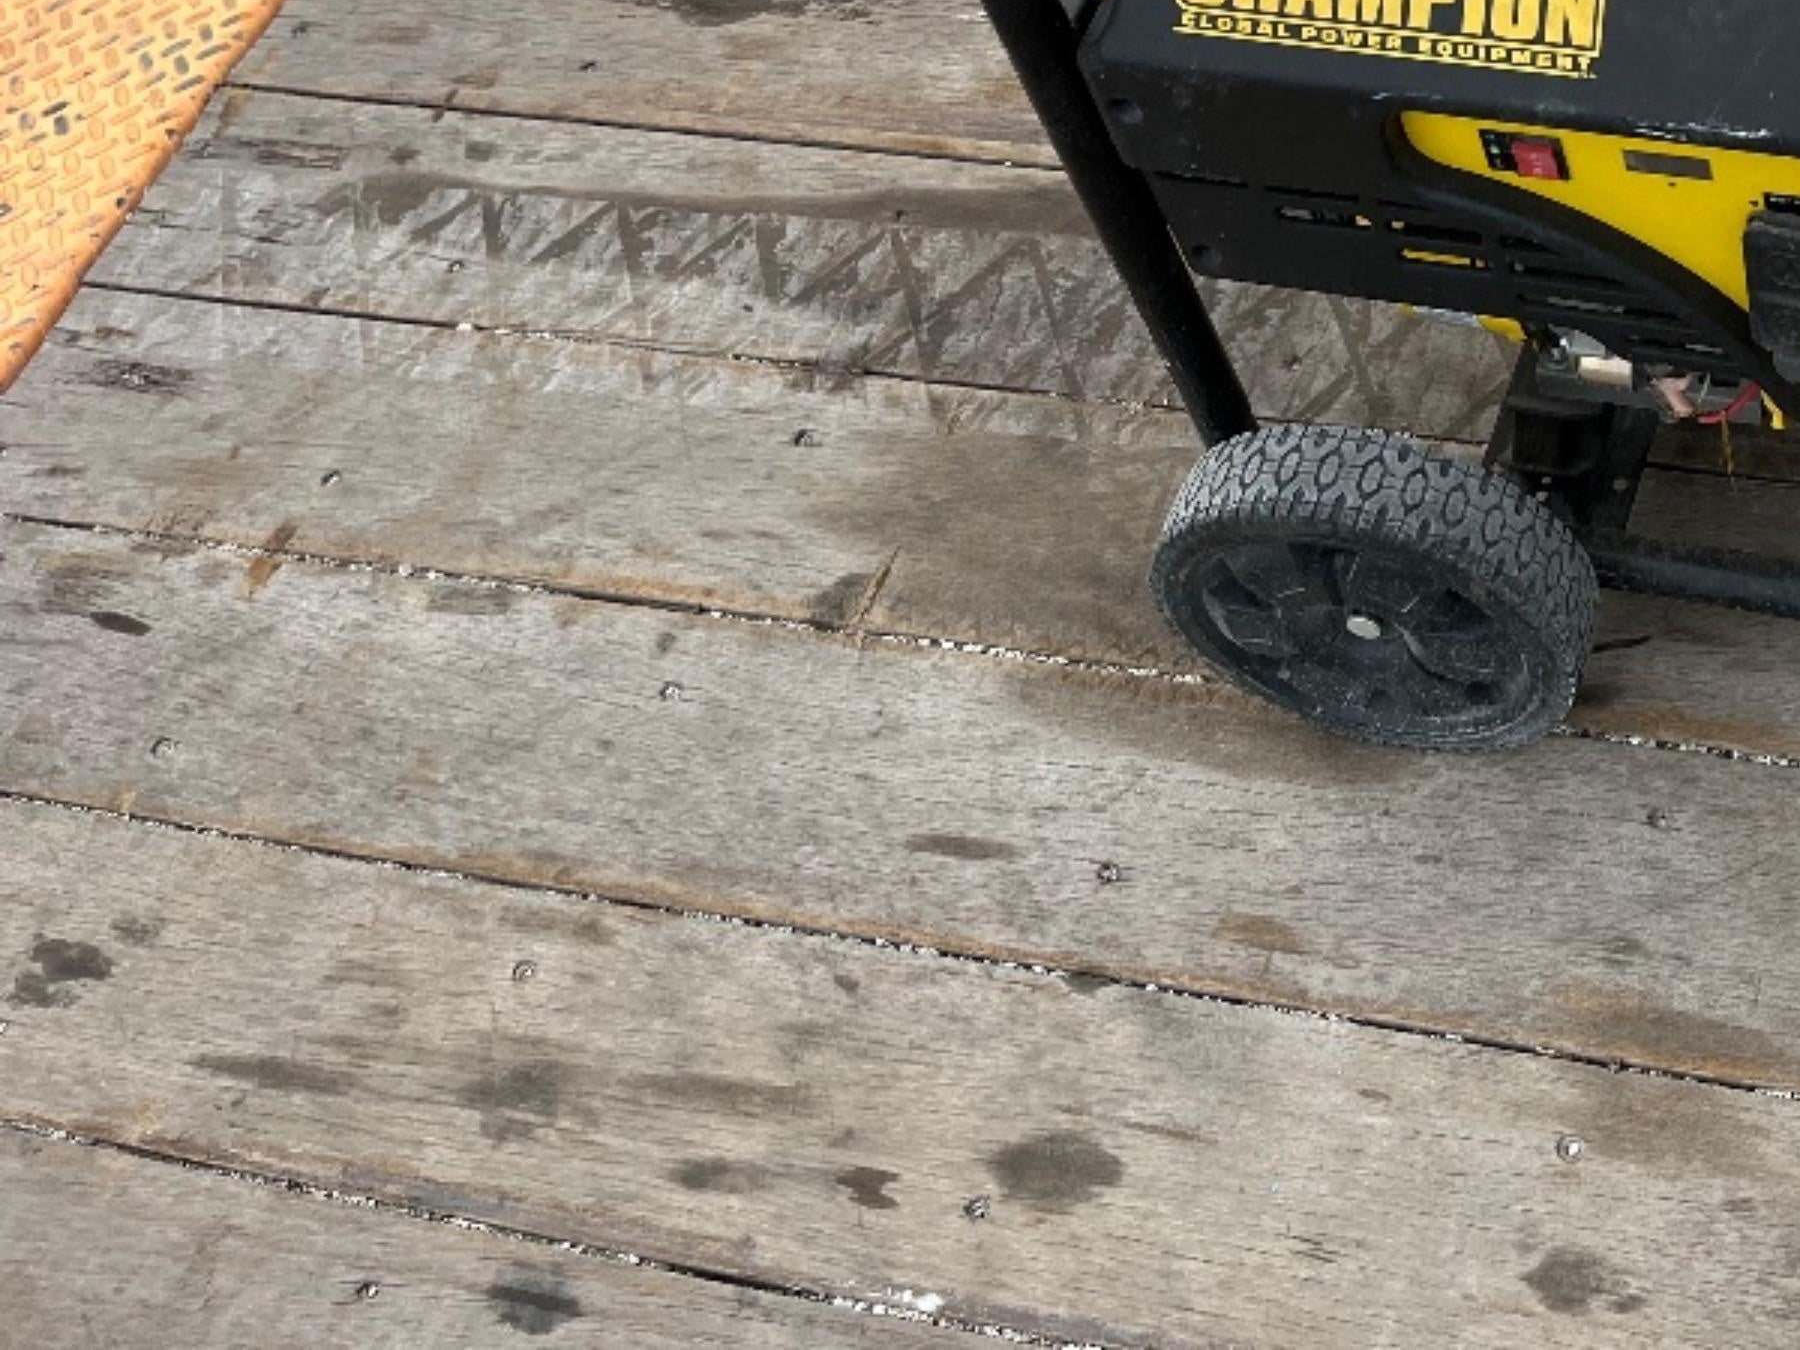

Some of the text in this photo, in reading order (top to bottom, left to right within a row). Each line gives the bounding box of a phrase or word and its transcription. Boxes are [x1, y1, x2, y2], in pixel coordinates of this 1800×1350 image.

[1180, 11, 1592, 72] GLOBAL POWER EQUIPMENT
